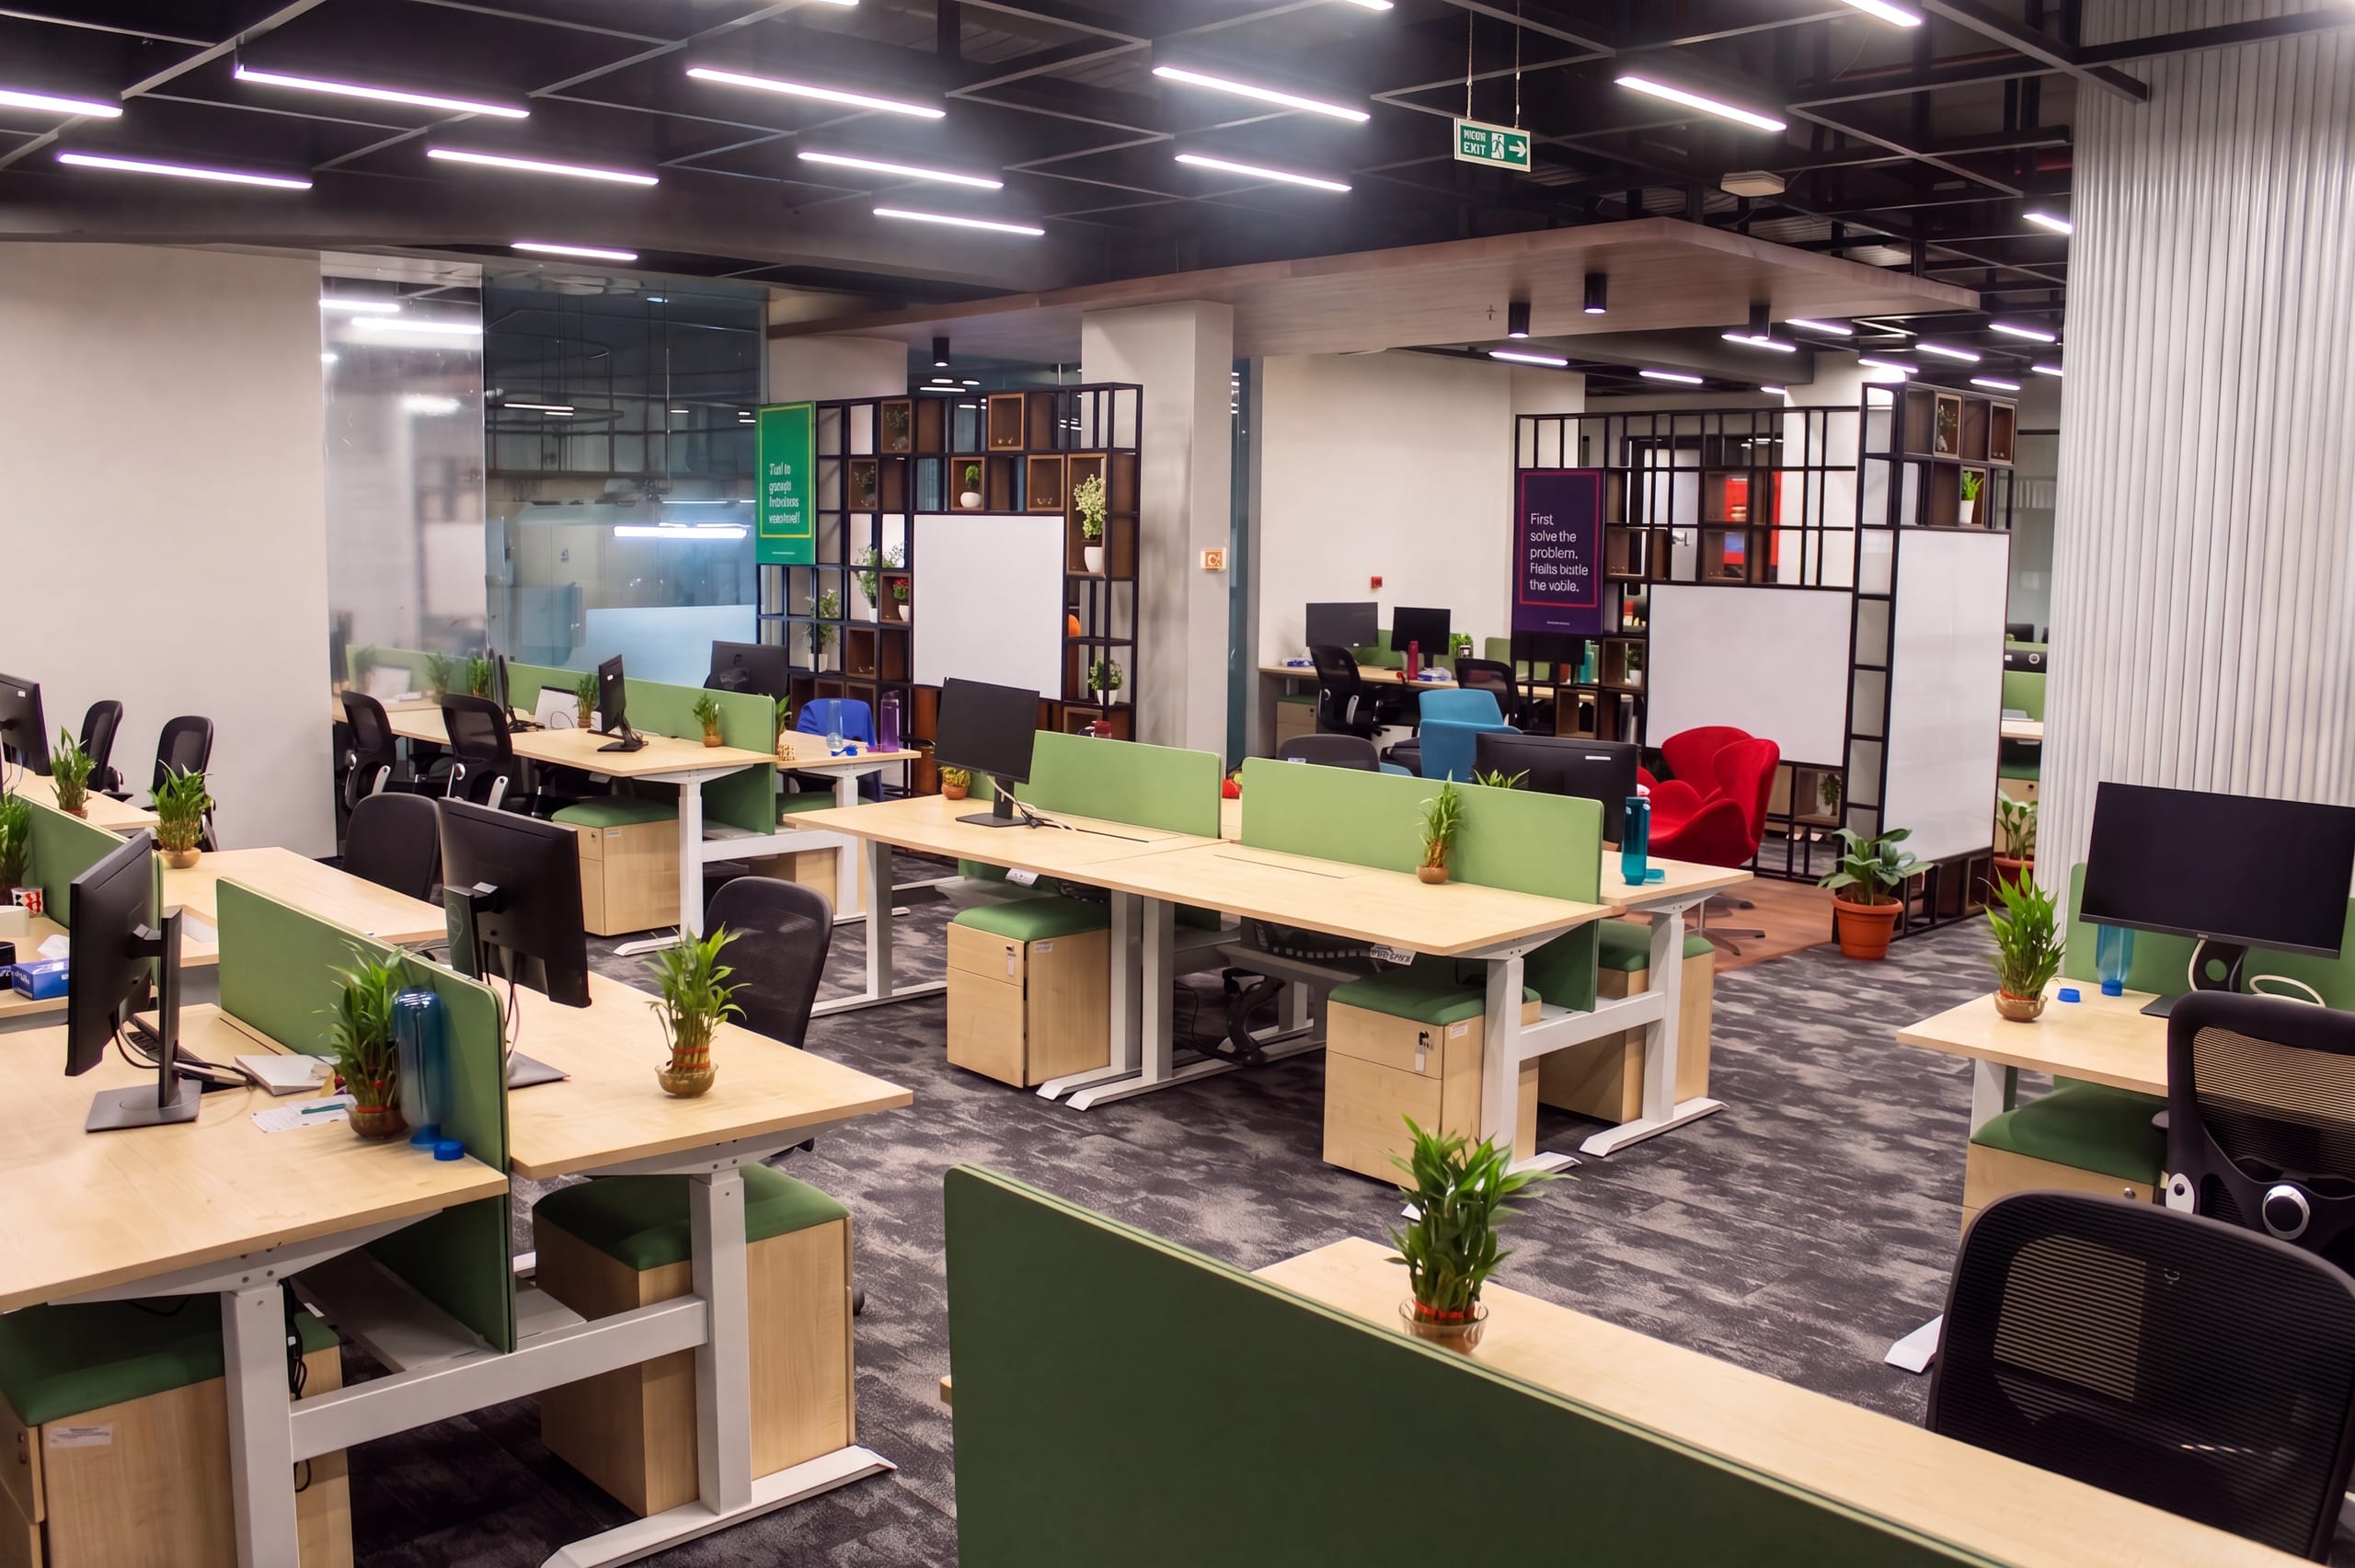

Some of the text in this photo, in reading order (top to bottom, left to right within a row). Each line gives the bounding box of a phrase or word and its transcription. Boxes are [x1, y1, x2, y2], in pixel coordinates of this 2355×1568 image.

[1464, 142, 1486, 155] EXIT
[1530, 530, 1577, 543] solve the
[1530, 546, 1579, 560] problem.
[1530, 578, 1546, 590] the
